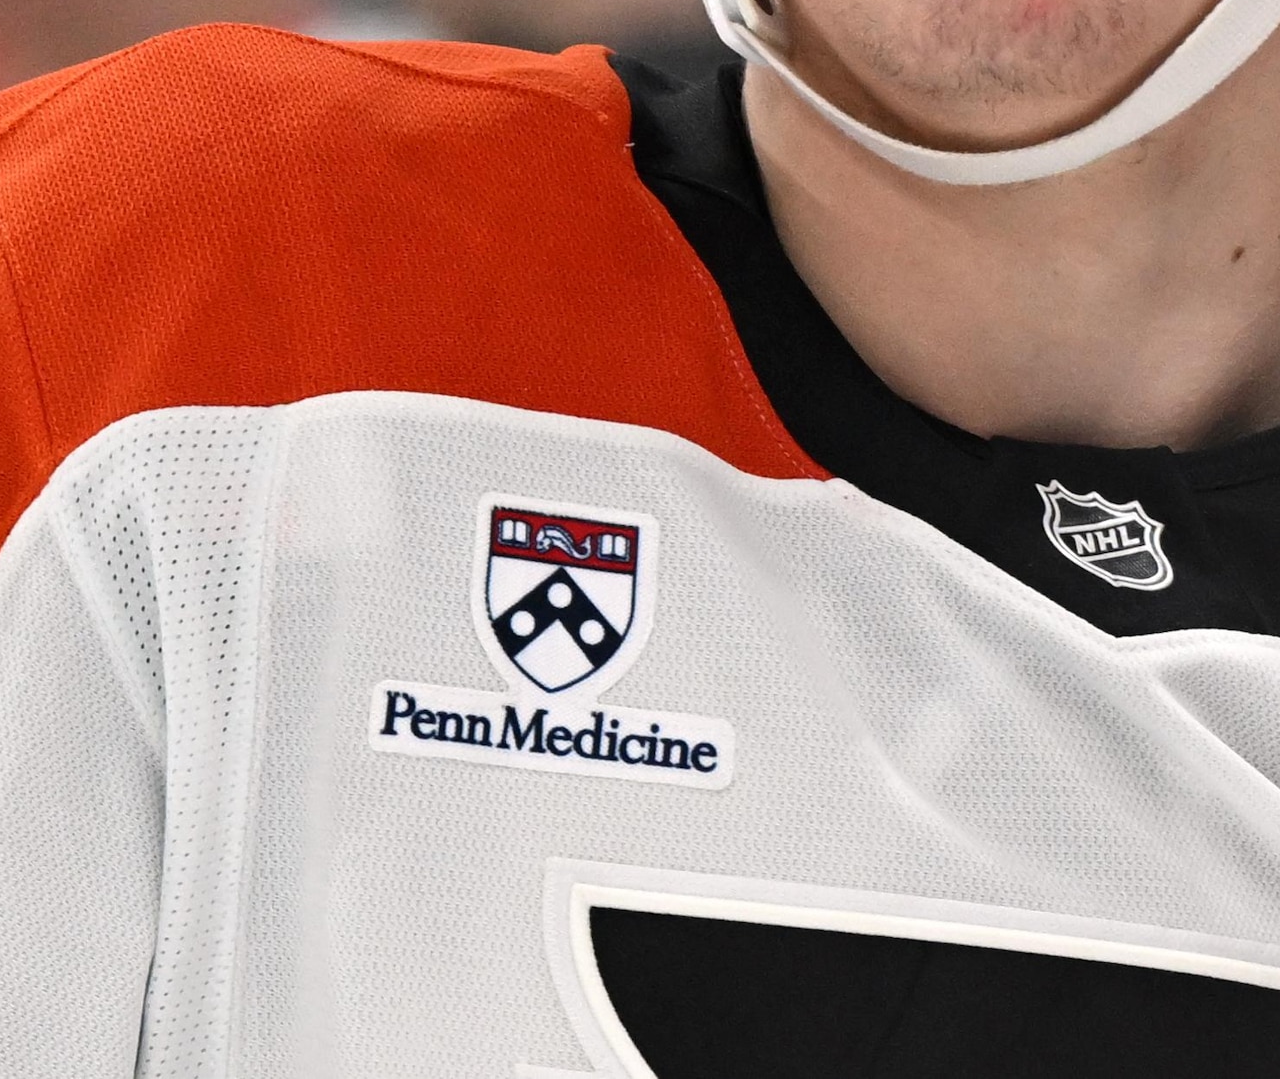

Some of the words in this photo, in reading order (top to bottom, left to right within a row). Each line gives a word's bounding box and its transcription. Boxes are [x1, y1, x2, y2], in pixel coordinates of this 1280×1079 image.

[1071, 525, 1141, 556] NHL
[379, 689, 493, 748] Penn
[496, 704, 719, 774] Medicine
